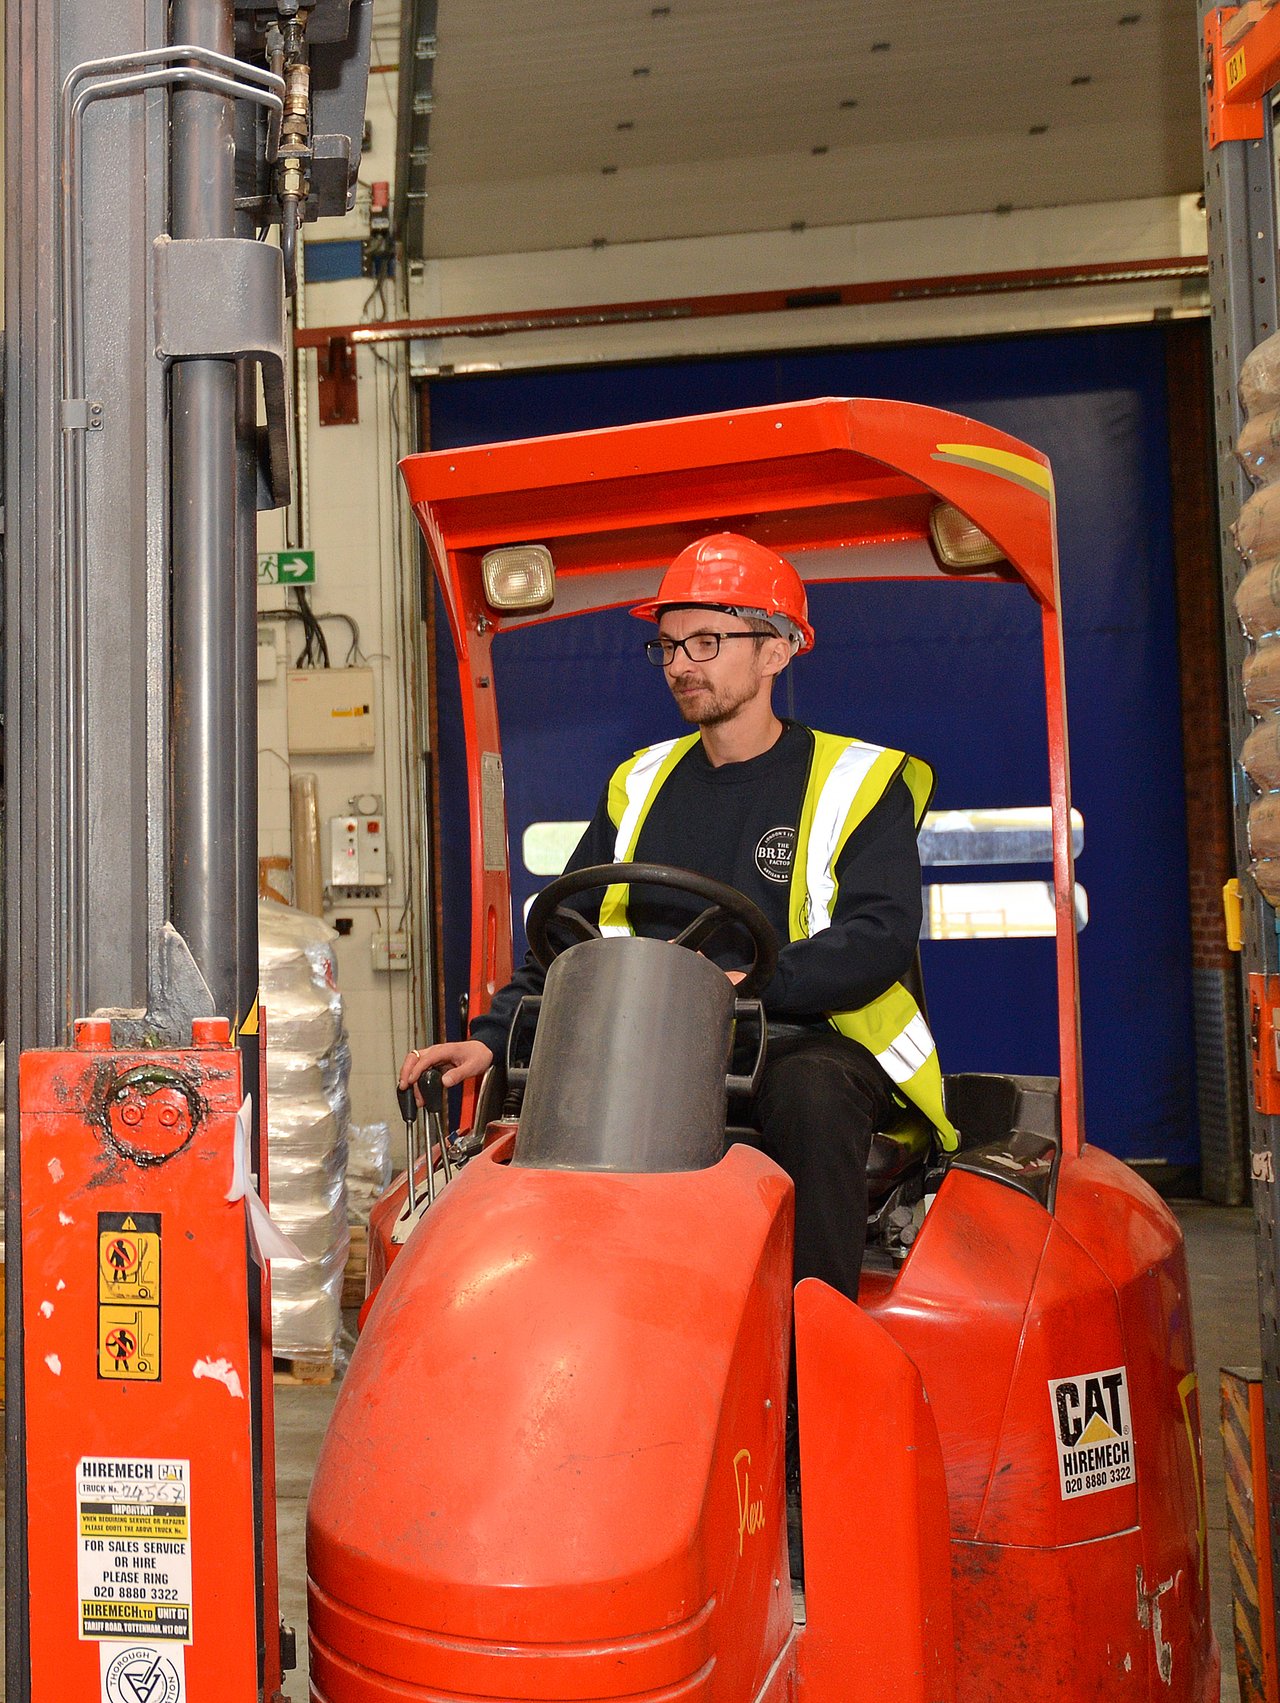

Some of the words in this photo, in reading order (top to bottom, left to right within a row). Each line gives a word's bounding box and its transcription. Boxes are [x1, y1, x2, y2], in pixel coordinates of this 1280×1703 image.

[764, 831, 787, 844] LONDON'S
[763, 867, 781, 879] ARTISAN
[1055, 1372, 1123, 1448] CAT
[1063, 1440, 1130, 1477] HIREMECH
[82, 1462, 153, 1479] HIREMECH
[158, 1464, 183, 1481] CAT
[1065, 1477, 1082, 1494] 020
[1086, 1471, 1107, 1489] 8880
[1110, 1466, 1131, 1483] 3322
[83, 1484, 106, 1493] TRUCK
[111, 1503, 155, 1516] IMPORTANT
[84, 1540, 104, 1552] FOR
[108, 1540, 139, 1553] SALES
[143, 1542, 186, 1555] SERVICE
[114, 1556, 129, 1568] OR
[132, 1557, 157, 1569] HIRE
[103, 1571, 140, 1584] PLEASE
[143, 1572, 169, 1585] RING
[93, 1586, 115, 1598] 020
[119, 1587, 146, 1599] 8880
[151, 1588, 178, 1601] 3322
[157, 1607, 177, 1620] UNIT
[84, 1621, 105, 1632] TARIFF
[162, 1625, 174, 1635] N17
[109, 1651, 150, 1687] THOROUGH
